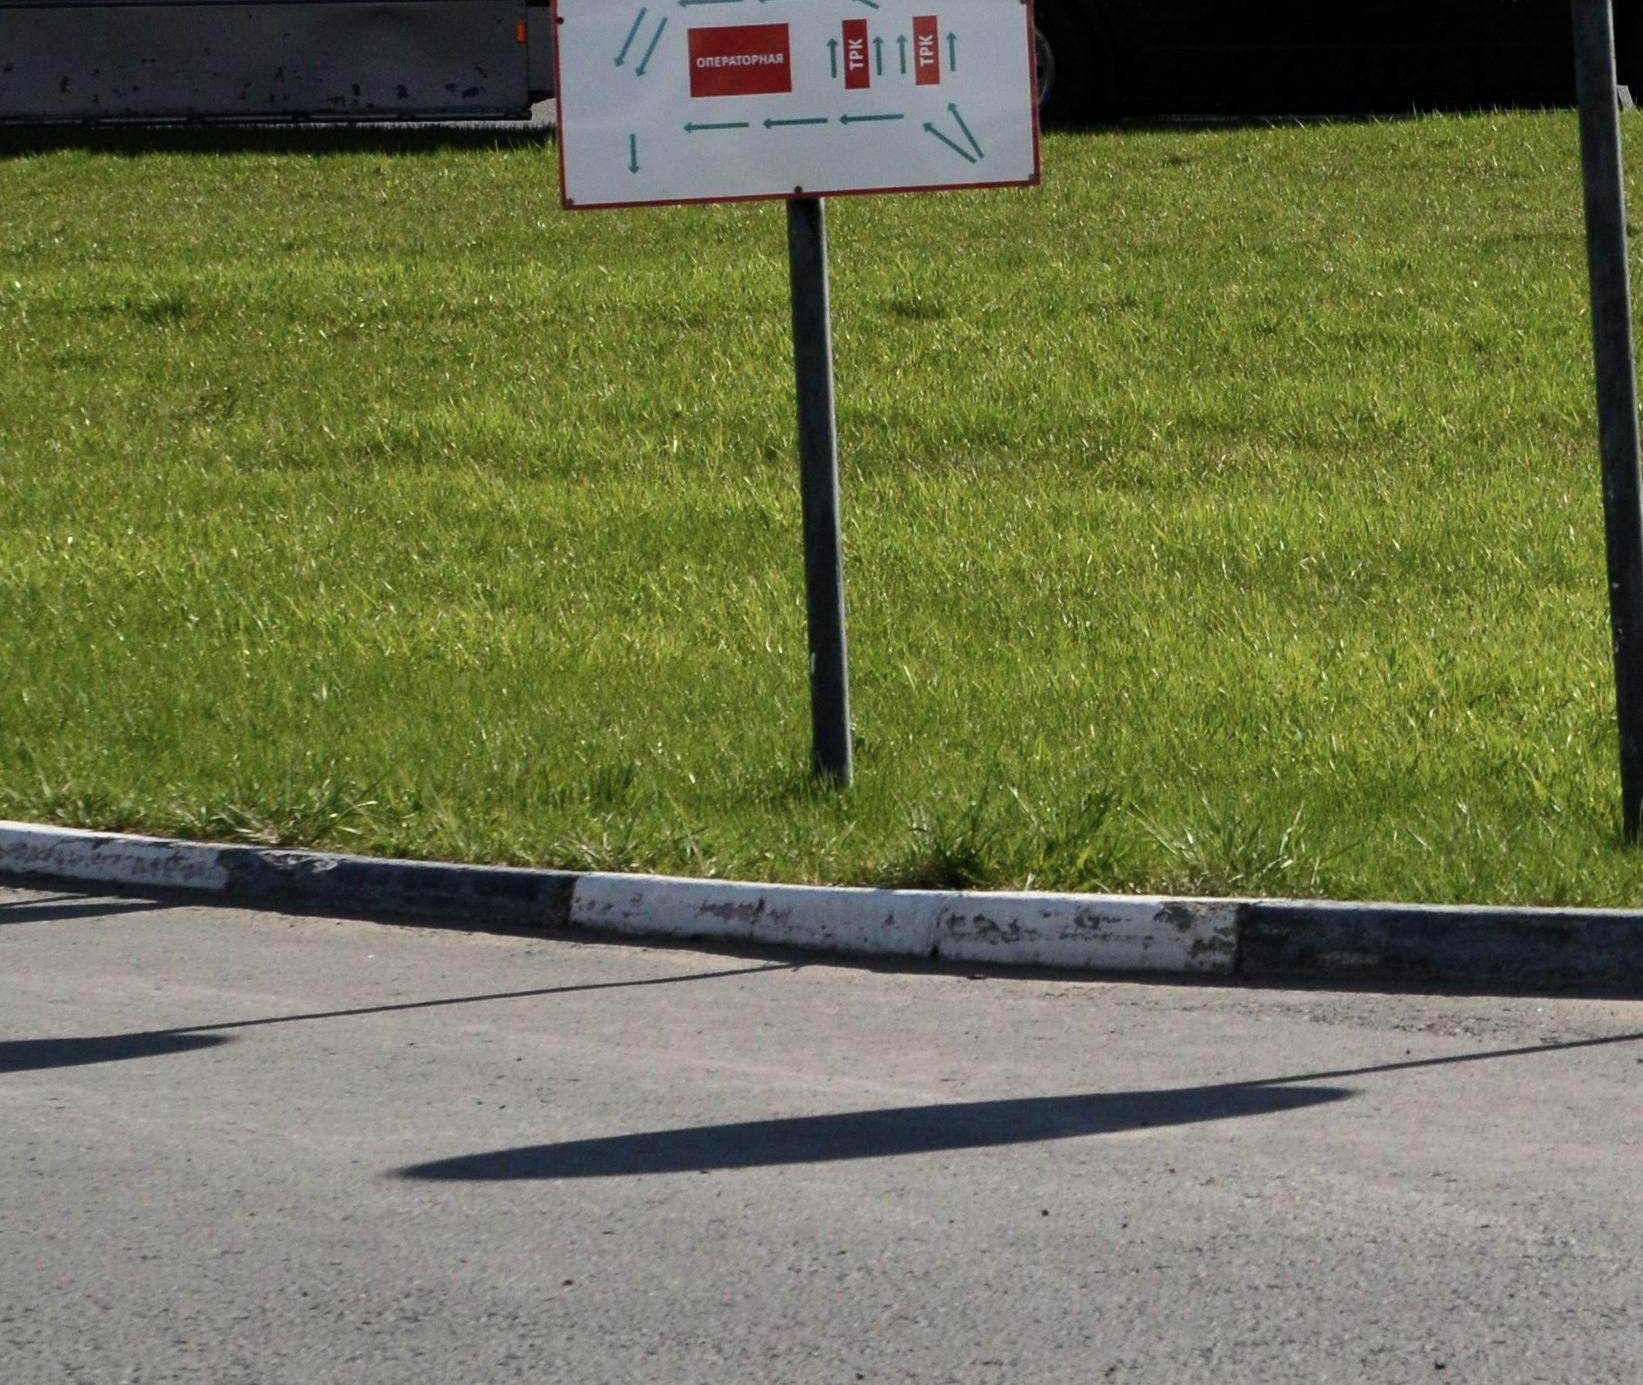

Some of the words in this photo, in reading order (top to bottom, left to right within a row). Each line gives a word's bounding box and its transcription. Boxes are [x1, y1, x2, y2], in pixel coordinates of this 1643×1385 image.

[696, 53, 784, 68] ОПЕРАТОРНАЯ
[849, 39, 864, 70] ТРК
[919, 34, 934, 67] ТРК
